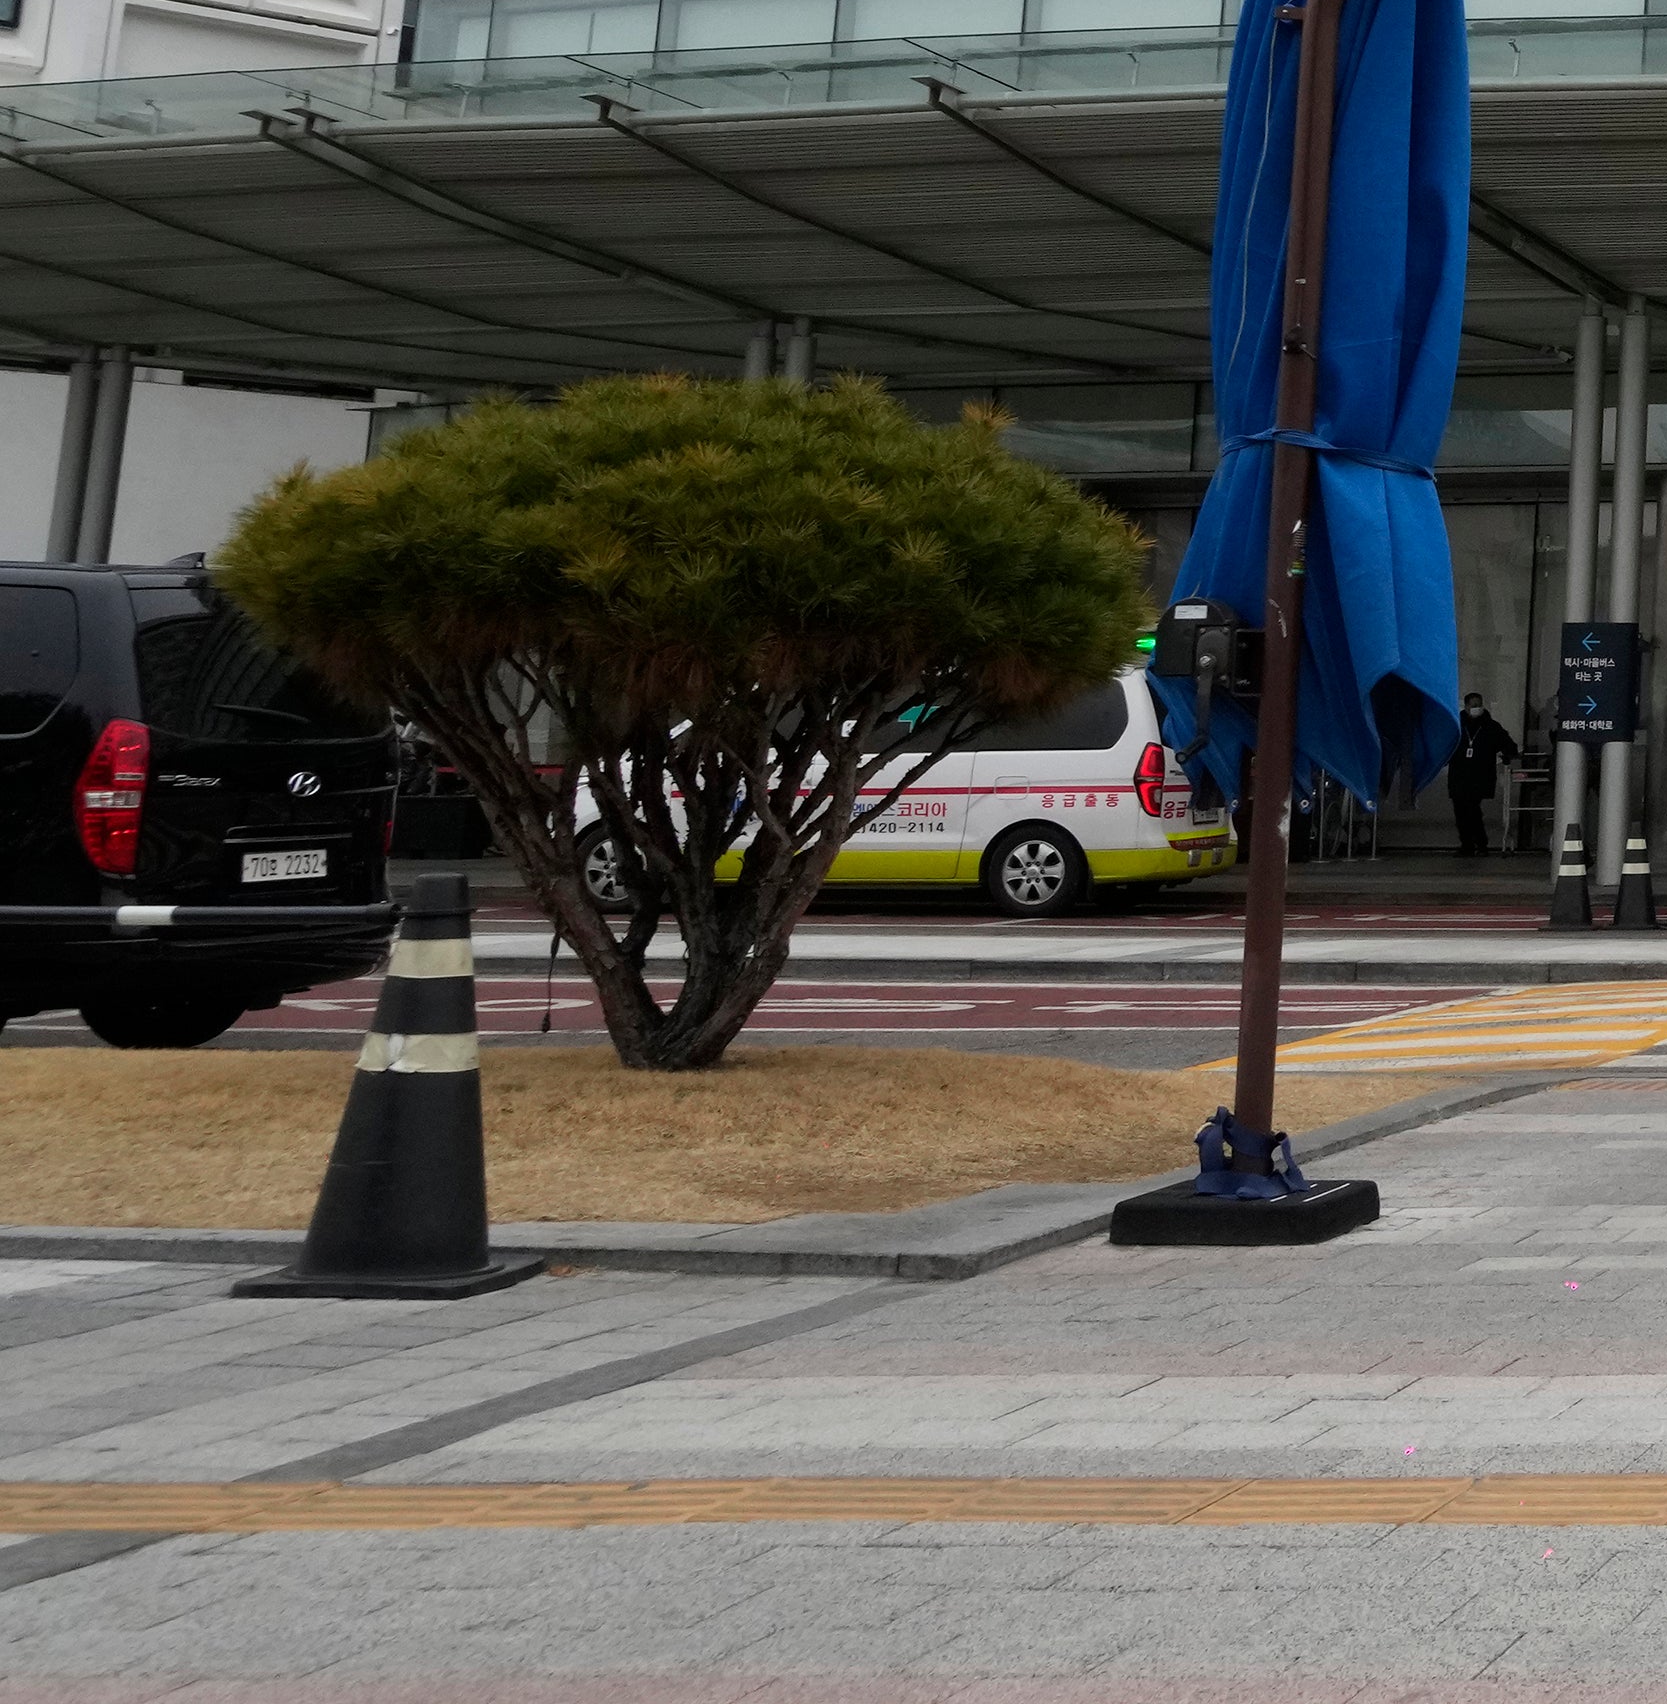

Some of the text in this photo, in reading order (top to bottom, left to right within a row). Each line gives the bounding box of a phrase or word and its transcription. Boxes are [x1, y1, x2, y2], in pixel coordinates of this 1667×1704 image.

[1575, 671, 1602, 682] 타는 곳
[284, 854, 320, 876] 2232
